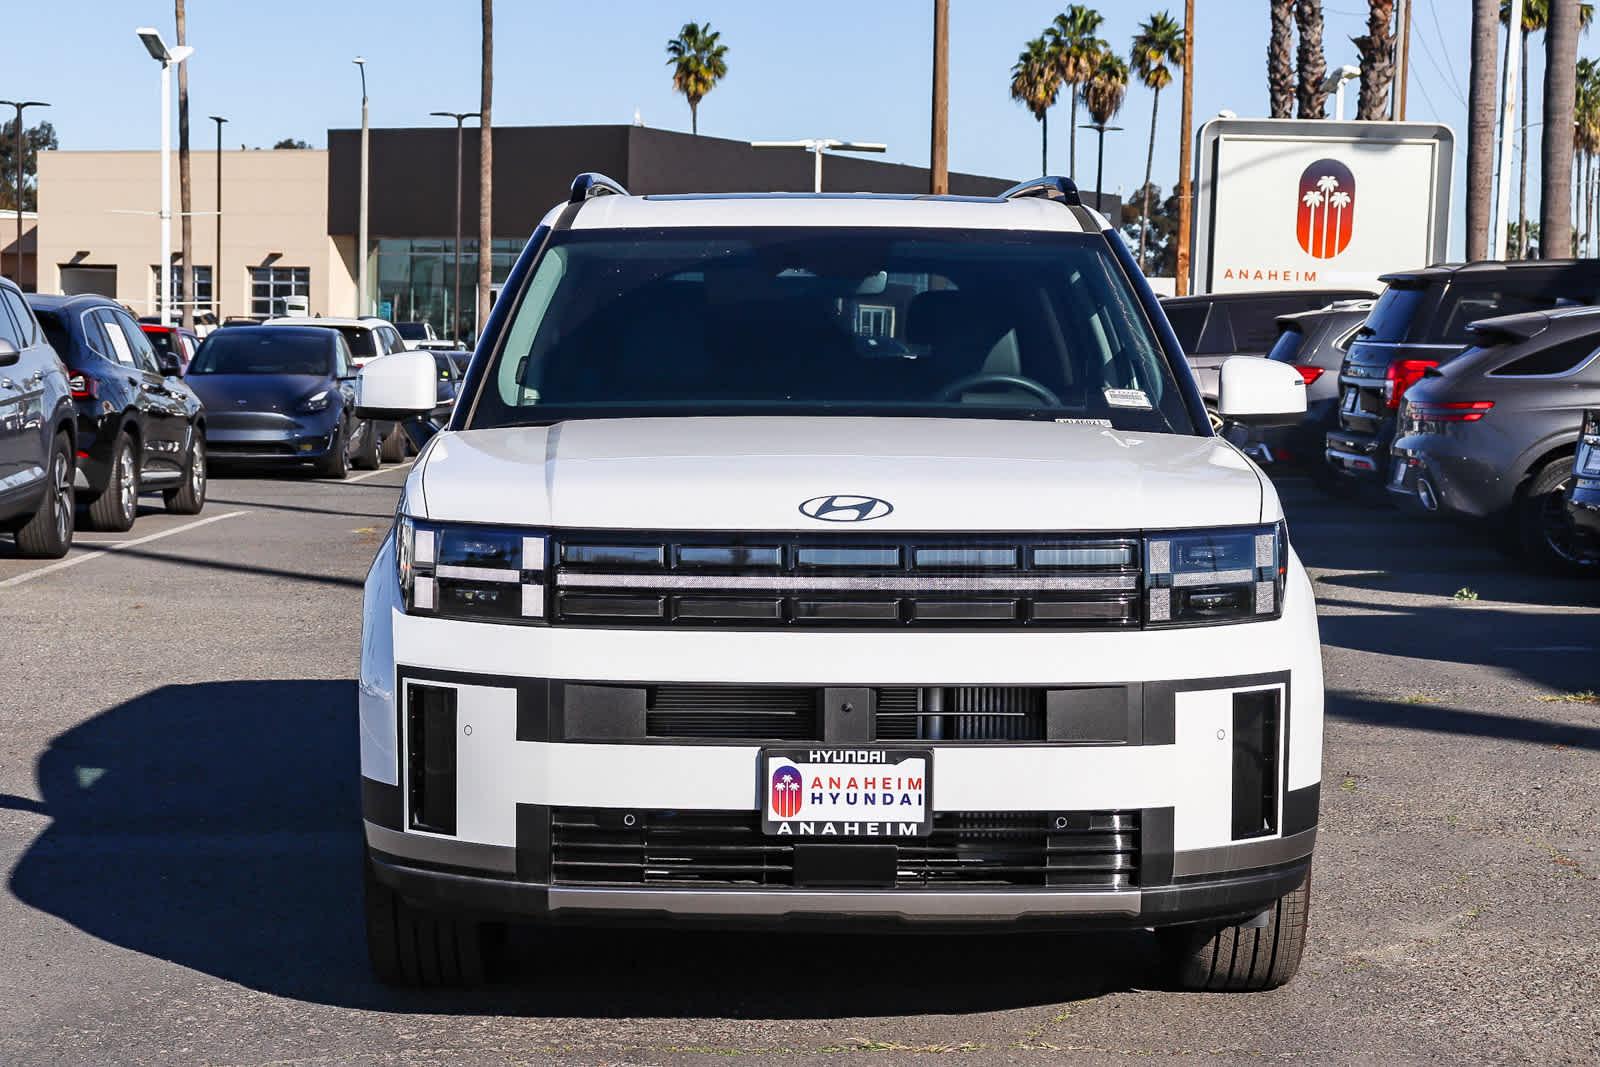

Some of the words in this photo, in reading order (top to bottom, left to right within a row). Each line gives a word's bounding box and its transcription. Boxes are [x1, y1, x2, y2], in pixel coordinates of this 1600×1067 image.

[1224, 268, 1317, 282] ANAHEIM
[809, 750, 886, 763] HYUNDAI
[811, 776, 922, 790] ANAHEIM
[811, 792, 922, 806] HYUNDAI
[777, 822, 918, 836] ANAHEIM
